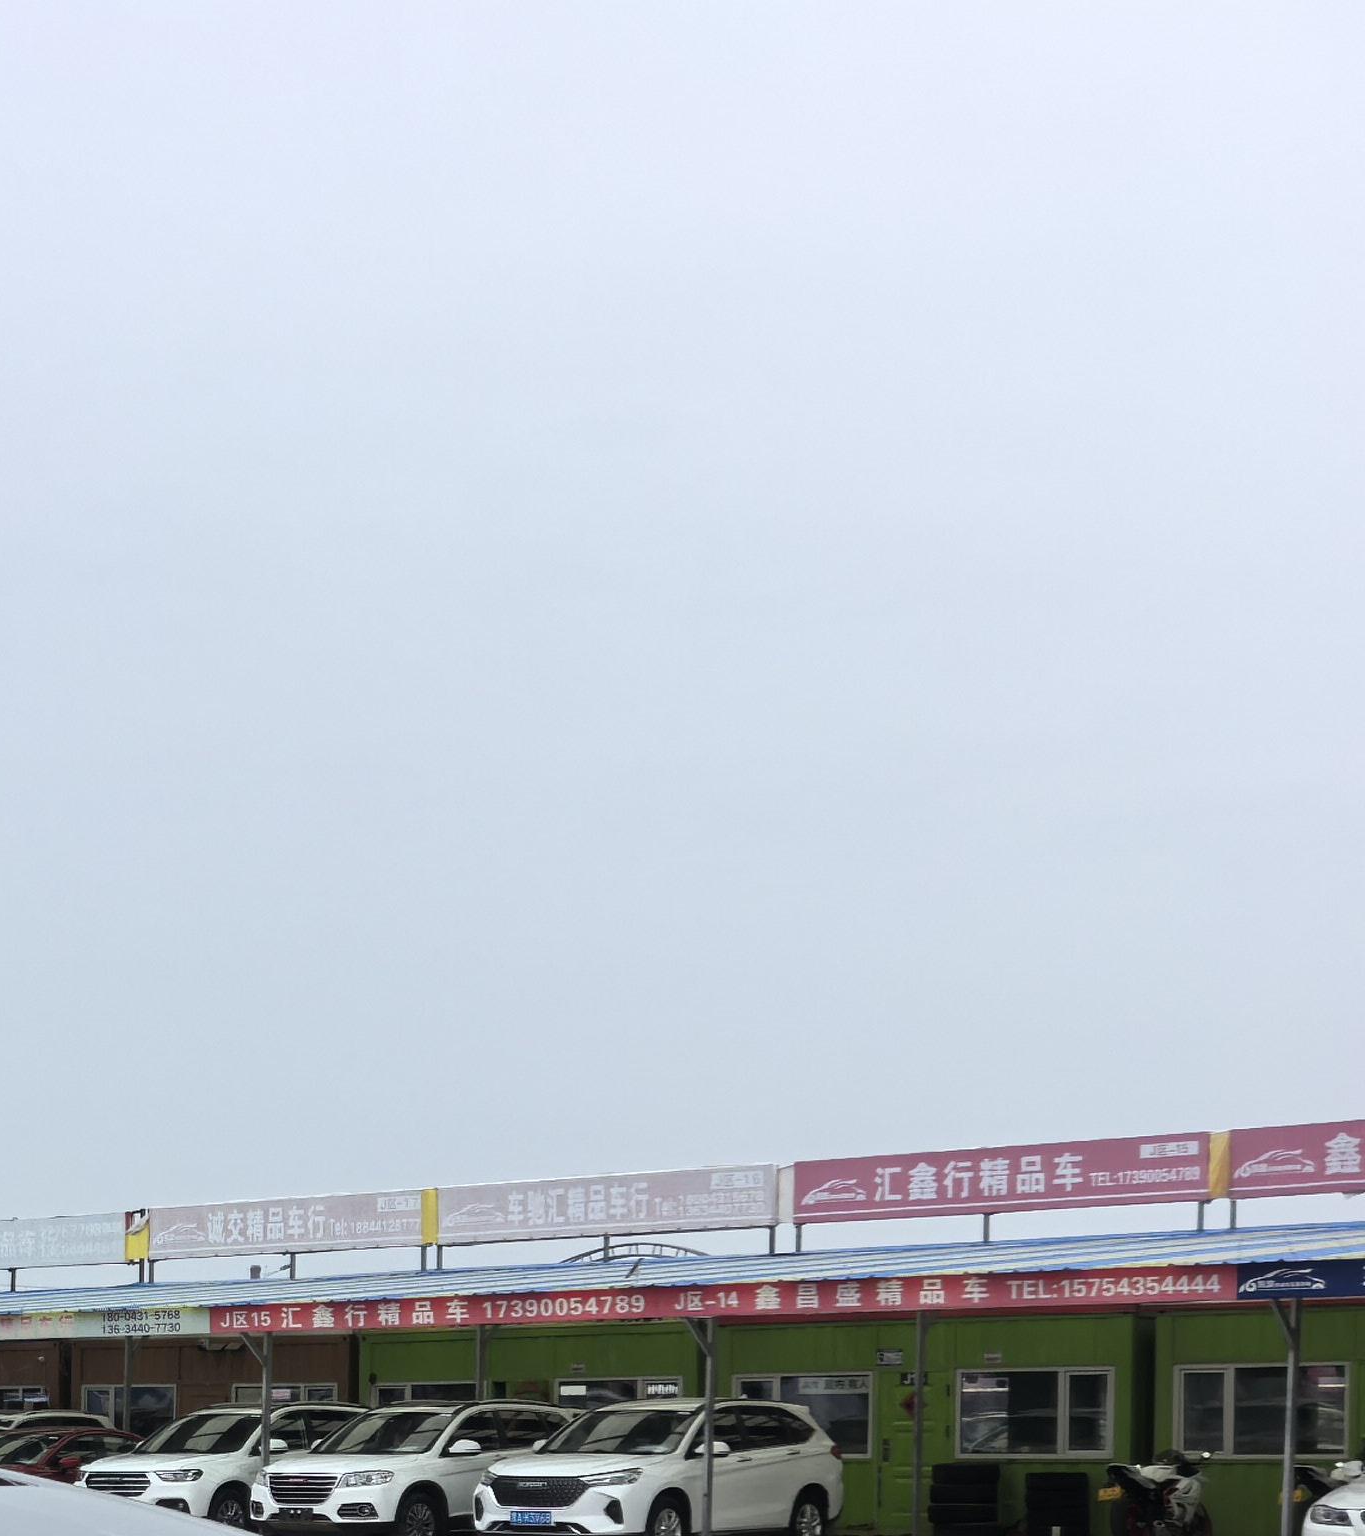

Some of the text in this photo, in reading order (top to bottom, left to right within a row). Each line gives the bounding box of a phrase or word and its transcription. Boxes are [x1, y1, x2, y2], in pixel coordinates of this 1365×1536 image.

[1324, 1132, 1362, 1175] 鑫
[874, 1152, 1084, 1202] 汇鑫行精品车
[207, 1205, 326, 1244] 诚交精品车行
[675, 1290, 739, 1311] J区-14
[754, 1273, 1221, 1310] 鑫昌盛精品车 TEL:15754354444
[220, 1295, 645, 1329] J区15 汇鑫行精品车 17390054789
